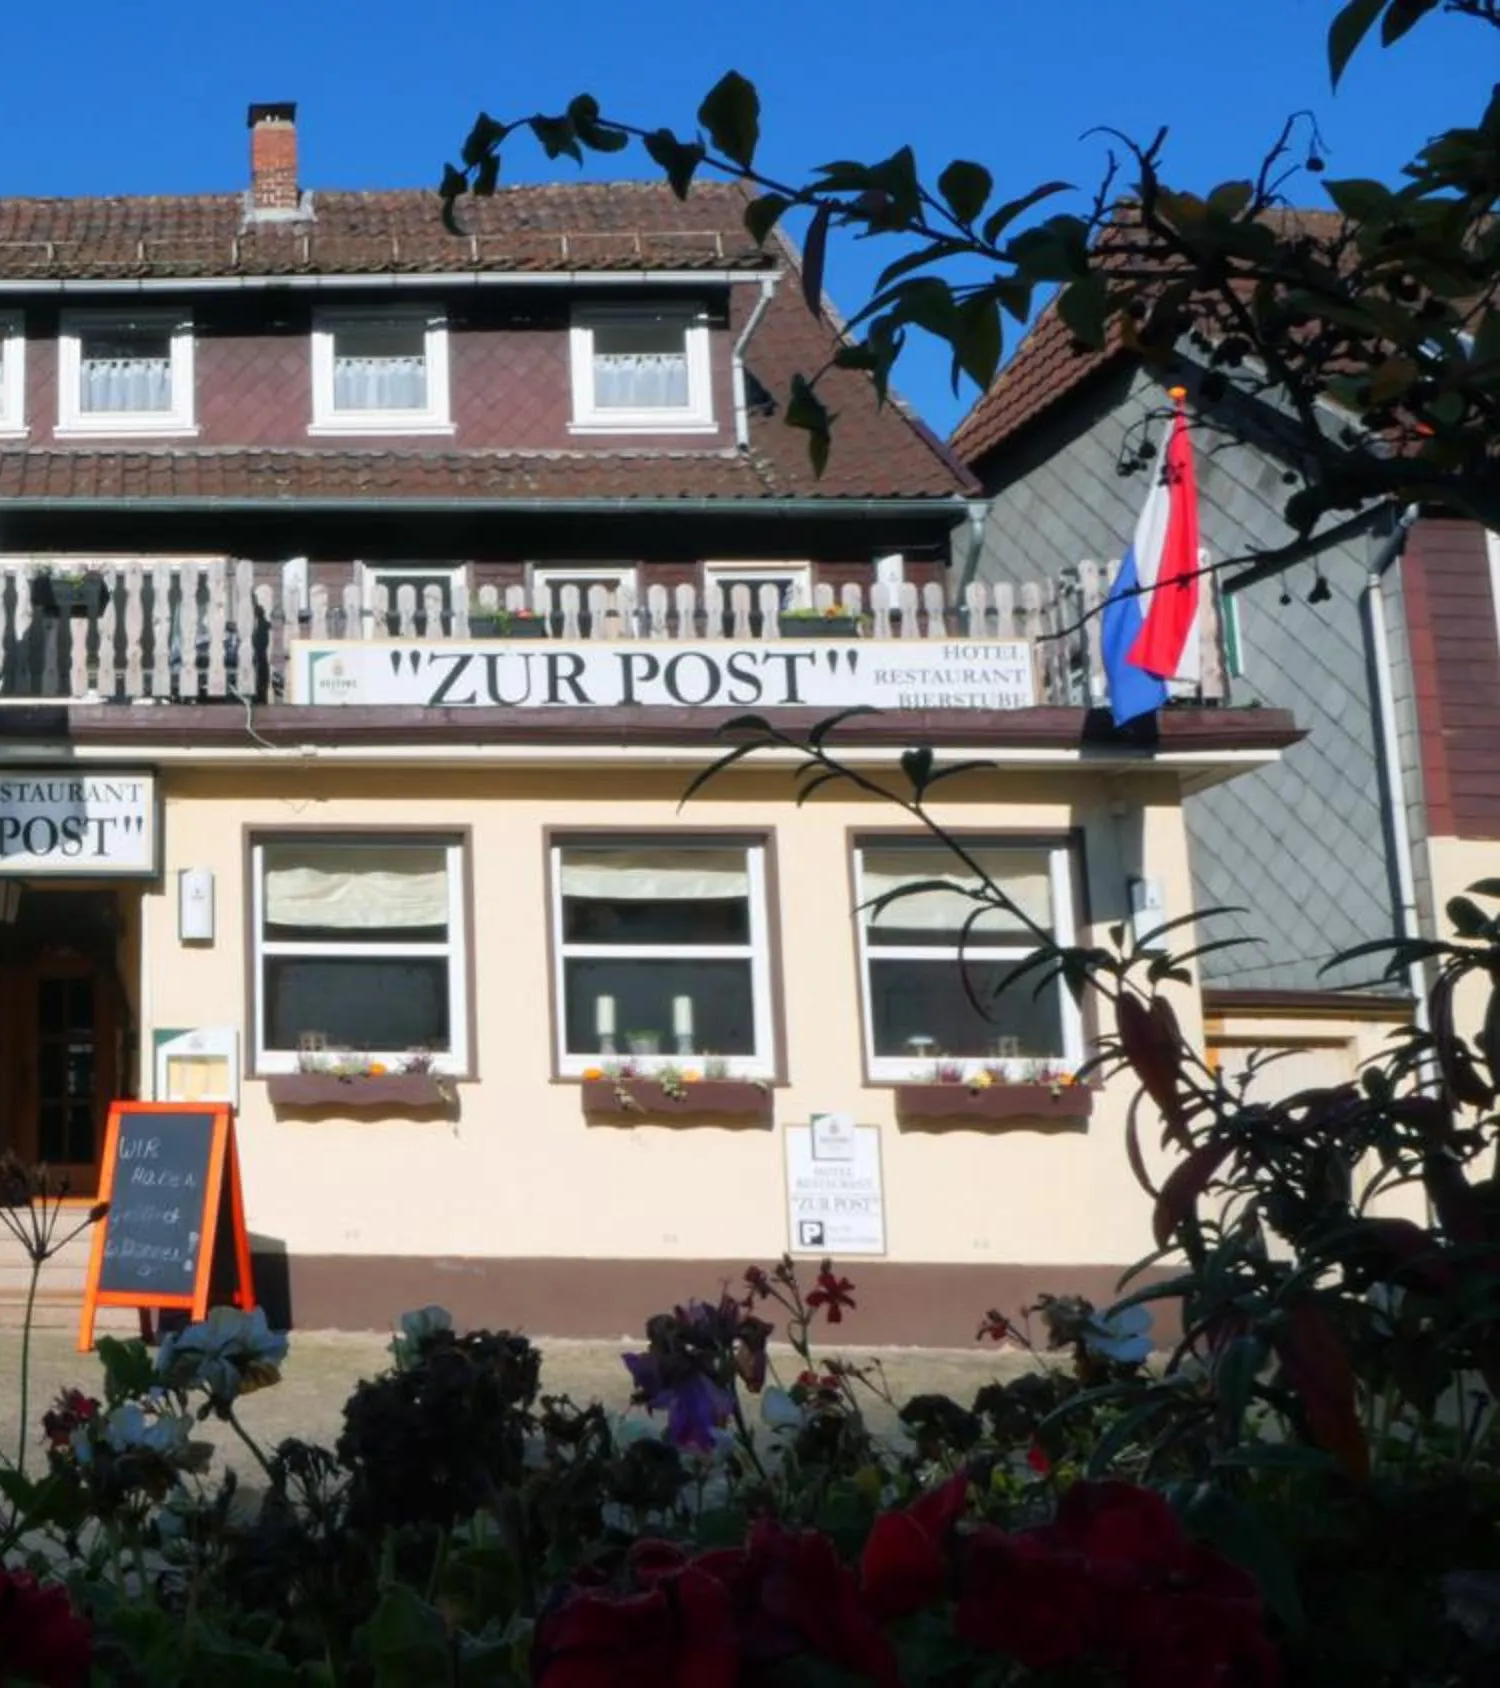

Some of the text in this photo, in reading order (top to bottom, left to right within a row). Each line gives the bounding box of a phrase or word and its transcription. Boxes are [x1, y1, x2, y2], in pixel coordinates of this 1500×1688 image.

[943, 645, 1023, 660] HOTEL
[389, 648, 860, 706] "ZUR POST"
[874, 668, 1026, 685] RESTAURANT
[899, 691, 1027, 709] BIERSTUBE
